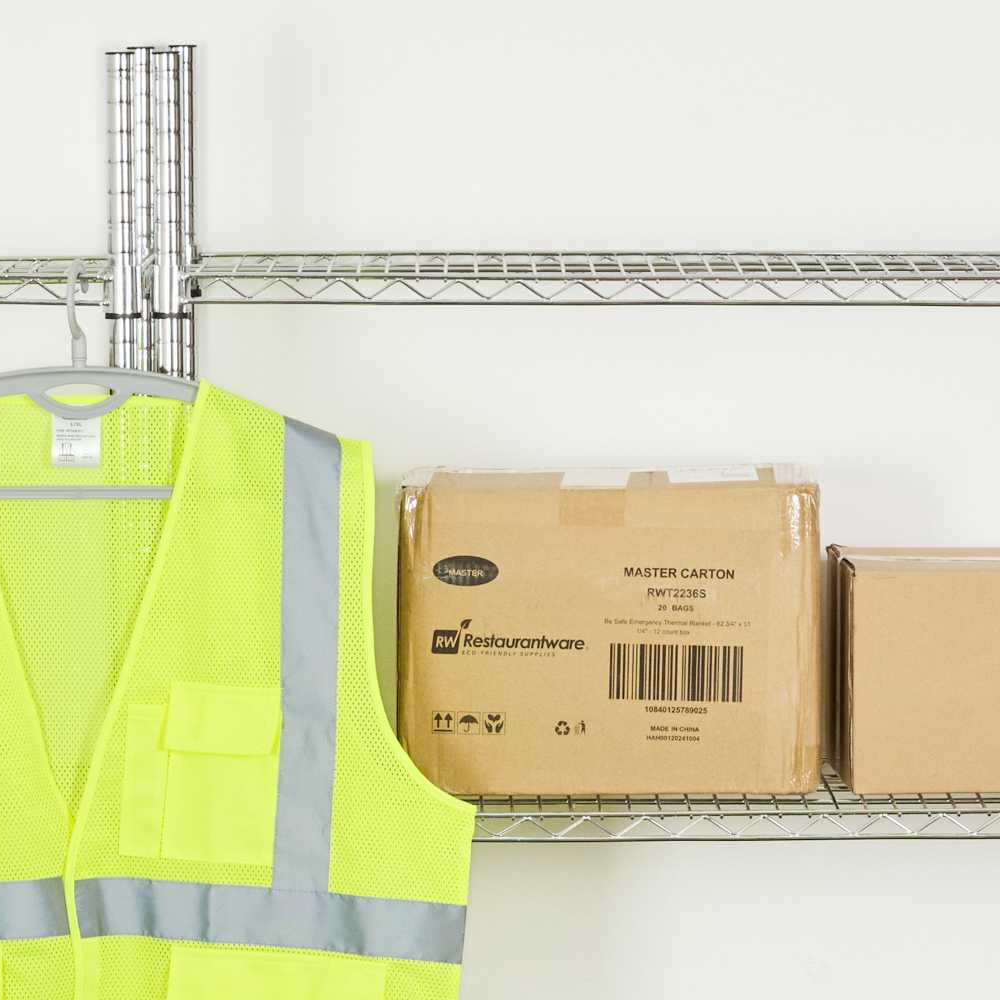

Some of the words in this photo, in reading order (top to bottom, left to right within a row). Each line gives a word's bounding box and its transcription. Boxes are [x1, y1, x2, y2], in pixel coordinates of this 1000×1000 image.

[448, 569, 484, 577] MASTER
[624, 567, 677, 578] MASTER
[680, 568, 735, 580] CARTON
[647, 588, 707, 599] RWT2236S
[435, 635, 457, 648] RW
[463, 633, 585, 650] Restaurantware
[645, 706, 708, 714] 10840125789025
